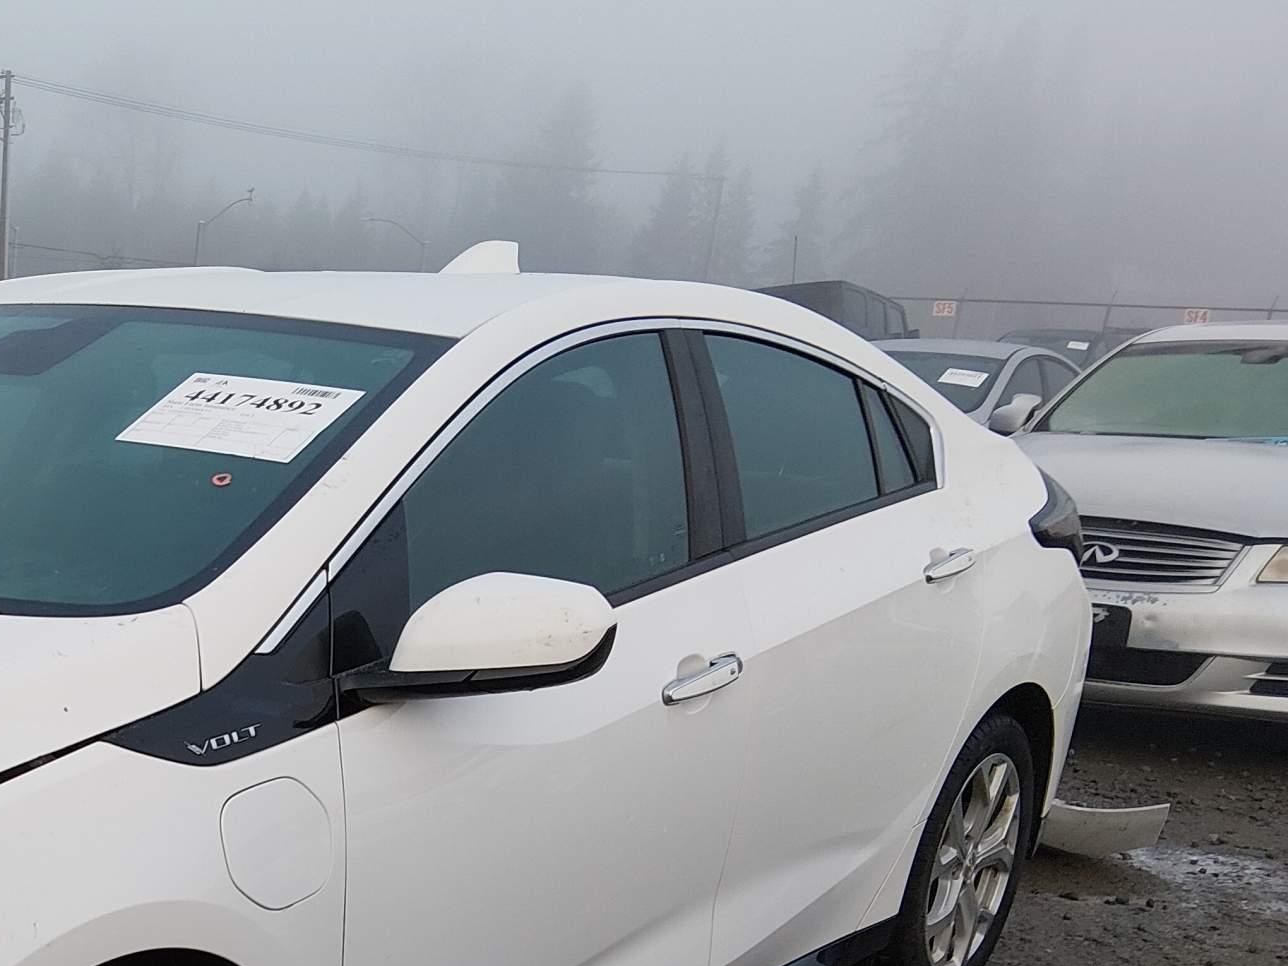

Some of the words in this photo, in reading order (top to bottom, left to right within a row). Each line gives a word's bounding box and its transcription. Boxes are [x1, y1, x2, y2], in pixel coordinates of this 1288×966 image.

[935, 302, 954, 314] SF5
[1186, 310, 1209, 323] SF4
[184, 389, 323, 416] 44174892
[184, 723, 261, 755] VOLT
